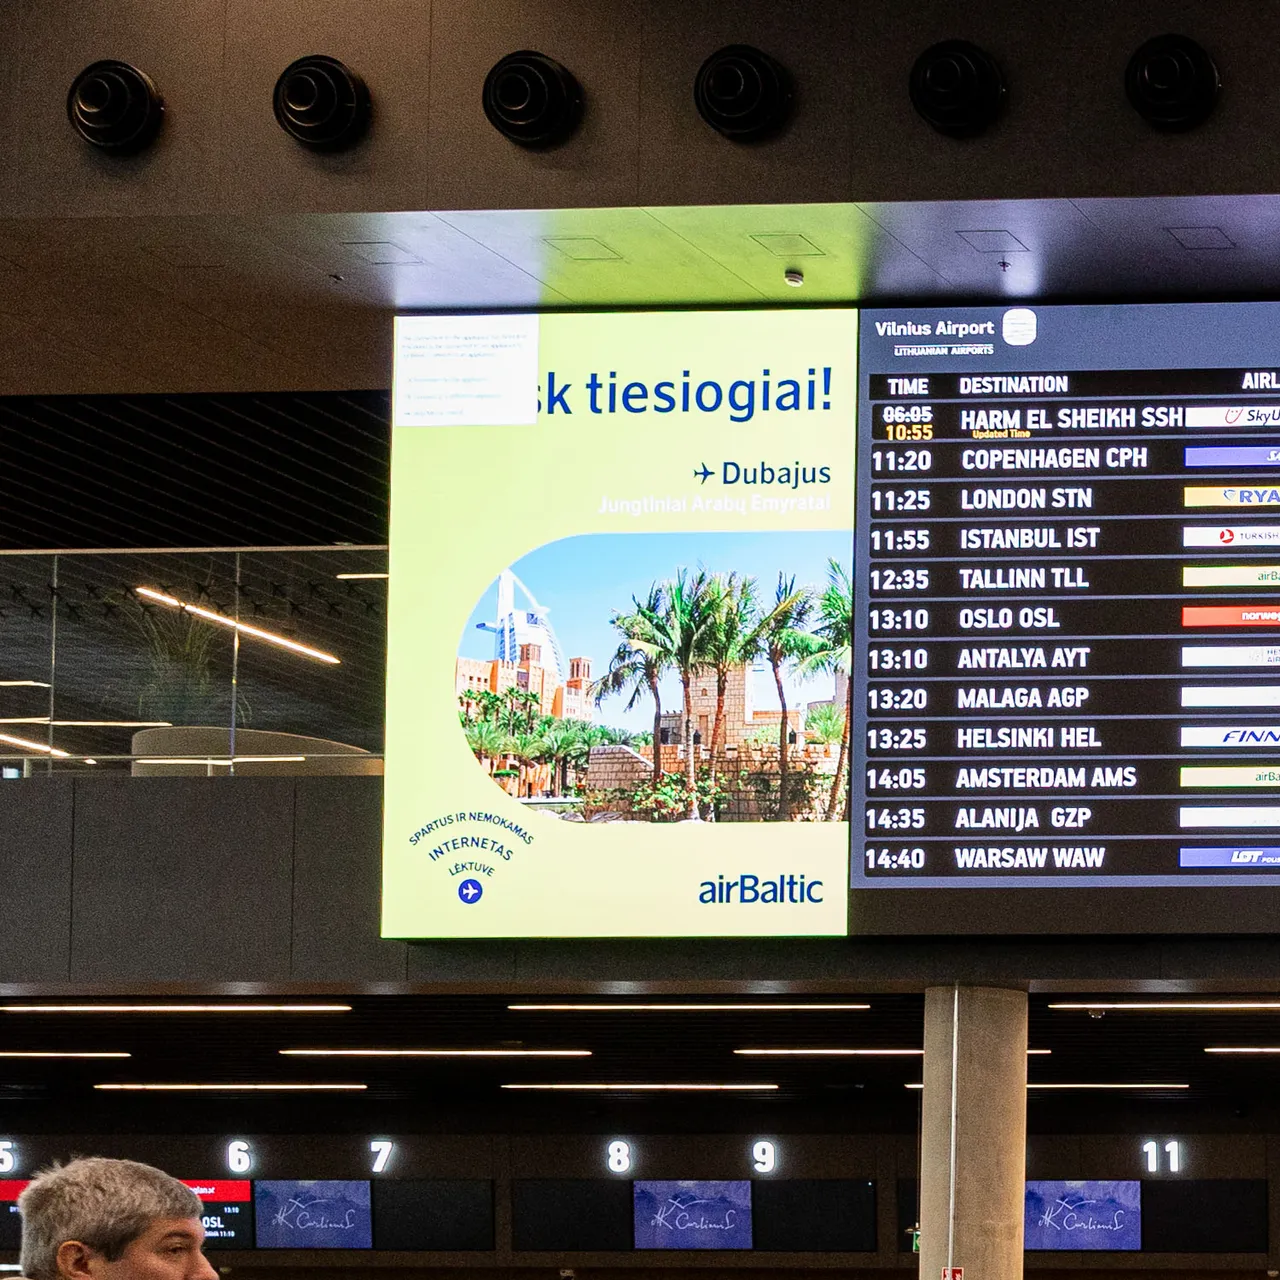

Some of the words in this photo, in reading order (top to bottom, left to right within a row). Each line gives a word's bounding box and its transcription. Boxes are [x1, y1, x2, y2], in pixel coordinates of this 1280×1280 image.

[875, 322, 931, 336] Vilnius
[936, 321, 994, 337] Airport
[894, 346, 948, 356] LITHUANIAN
[951, 345, 994, 356] AIRPORTS
[586, 367, 831, 422] tiesiogiai!
[888, 378, 928, 394] TIME
[960, 376, 1068, 394] DESTINATION
[883, 406, 933, 422] 06:05
[961, 410, 1020, 430] HARM
[1026, 409, 1053, 429] EL
[1058, 408, 1135, 428] SHEIKH
[1142, 407, 1183, 427] SSH
[886, 425, 932, 441] 10:55
[973, 429, 1007, 439] Updated
[1009, 429, 1031, 439] Time
[873, 450, 931, 470] 11:20
[962, 448, 1099, 469] COPENHAGEN
[1106, 448, 1147, 467] CPH
[723, 461, 830, 489] Dubajus
[872, 490, 930, 510] 11:25
[962, 489, 1046, 509] LONDON
[1052, 488, 1092, 507] STN
[961, 529, 1061, 548] ISTANBUL
[1067, 528, 1100, 547] IST
[959, 568, 1045, 588] TALLINN
[1051, 568, 1089, 587] TLL
[960, 608, 1012, 628] OSLO
[1019, 608, 1060, 628] OSL
[958, 648, 1047, 668] ANTALYA
[1051, 648, 1090, 667] AYT
[958, 688, 1042, 708] MALAGA
[1047, 688, 1089, 707] AGP
[958, 728, 1053, 748] HELSINKI
[1061, 728, 1101, 747] HEL
[956, 768, 1085, 788] AMSTERDAM
[1091, 767, 1136, 787] AMS
[409, 815, 454, 846] SPARTUS
[456, 812, 467, 822] IR
[469, 812, 534, 845] NEMOKAMAS
[955, 808, 1039, 832] ALANIJA
[1052, 807, 1091, 827] GZP
[428, 836, 514, 861] INTERNETAS
[955, 848, 1048, 868] WARSAW
[1052, 848, 1105, 867] WAW
[866, 849, 925, 869] 14:40
[449, 862, 494, 877] LĖKTUVE
[699, 875, 823, 904] airBaltic
[228, 1140, 251, 1173] 6
[370, 1141, 393, 1173] 7
[608, 1140, 631, 1173] 8
[752, 1141, 775, 1173] 9
[1142, 1140, 1179, 1173] 11
[202, 1217, 225, 1230] OSL
